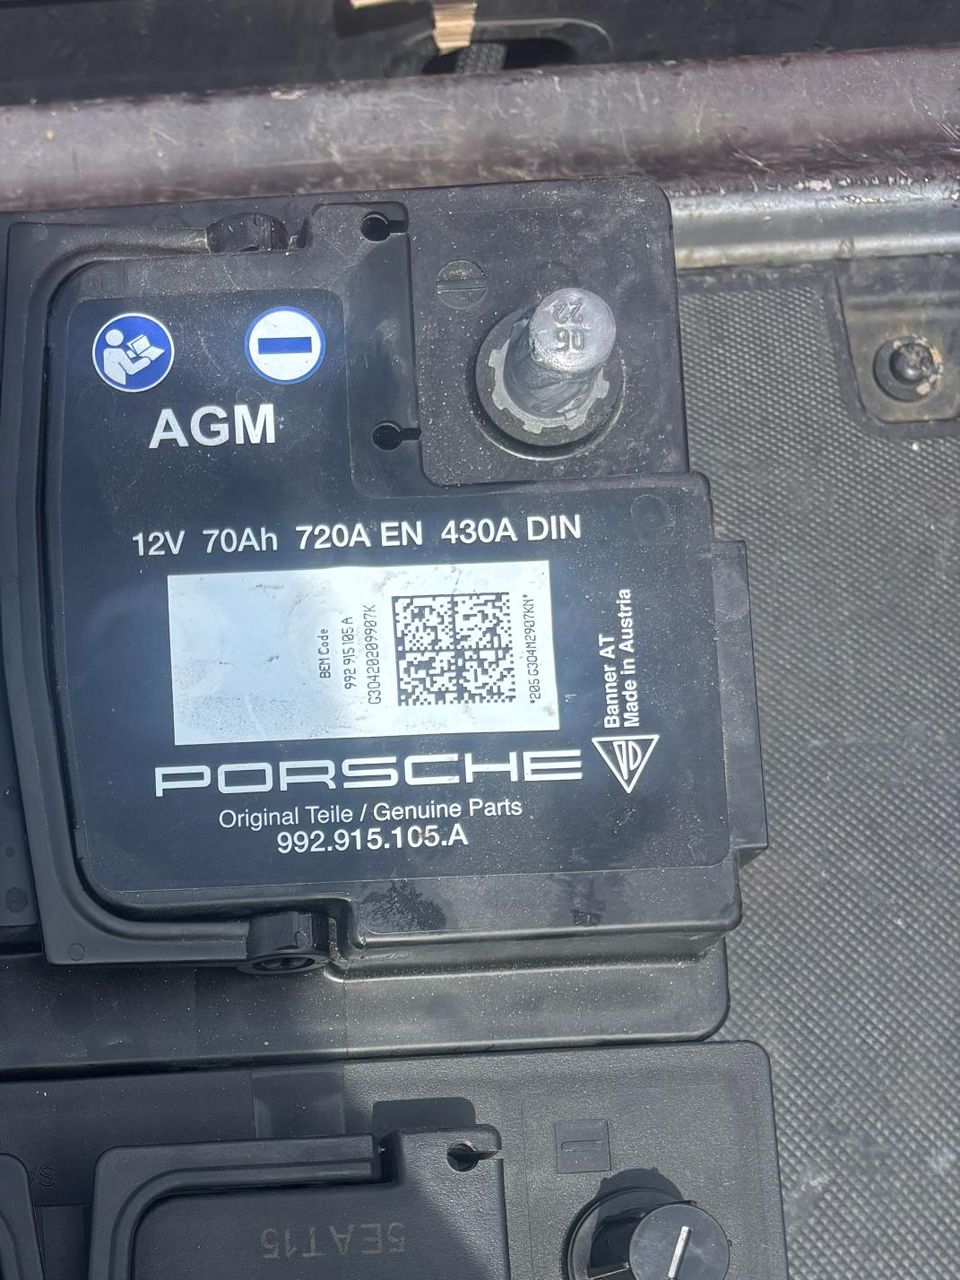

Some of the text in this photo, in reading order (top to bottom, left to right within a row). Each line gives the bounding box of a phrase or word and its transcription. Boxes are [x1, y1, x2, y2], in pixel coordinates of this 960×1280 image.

[149, 403, 276, 449] AGM
[132, 513, 581, 555] 12V 70Ah 720A EN 430A DIN
[317, 628, 331, 678] BEM Code
[342, 647, 355, 665] 915
[616, 588, 639, 727] Made in Austria
[343, 667, 356, 689] 992
[598, 633, 619, 728] Banner AT
[155, 749, 583, 797] PORSCHE
[218, 806, 298, 828] Original
[304, 804, 353, 823] Teile
[373, 799, 461, 821] Genuine
[469, 798, 522, 816] Parts
[277, 825, 470, 855] 992.915.105.A
